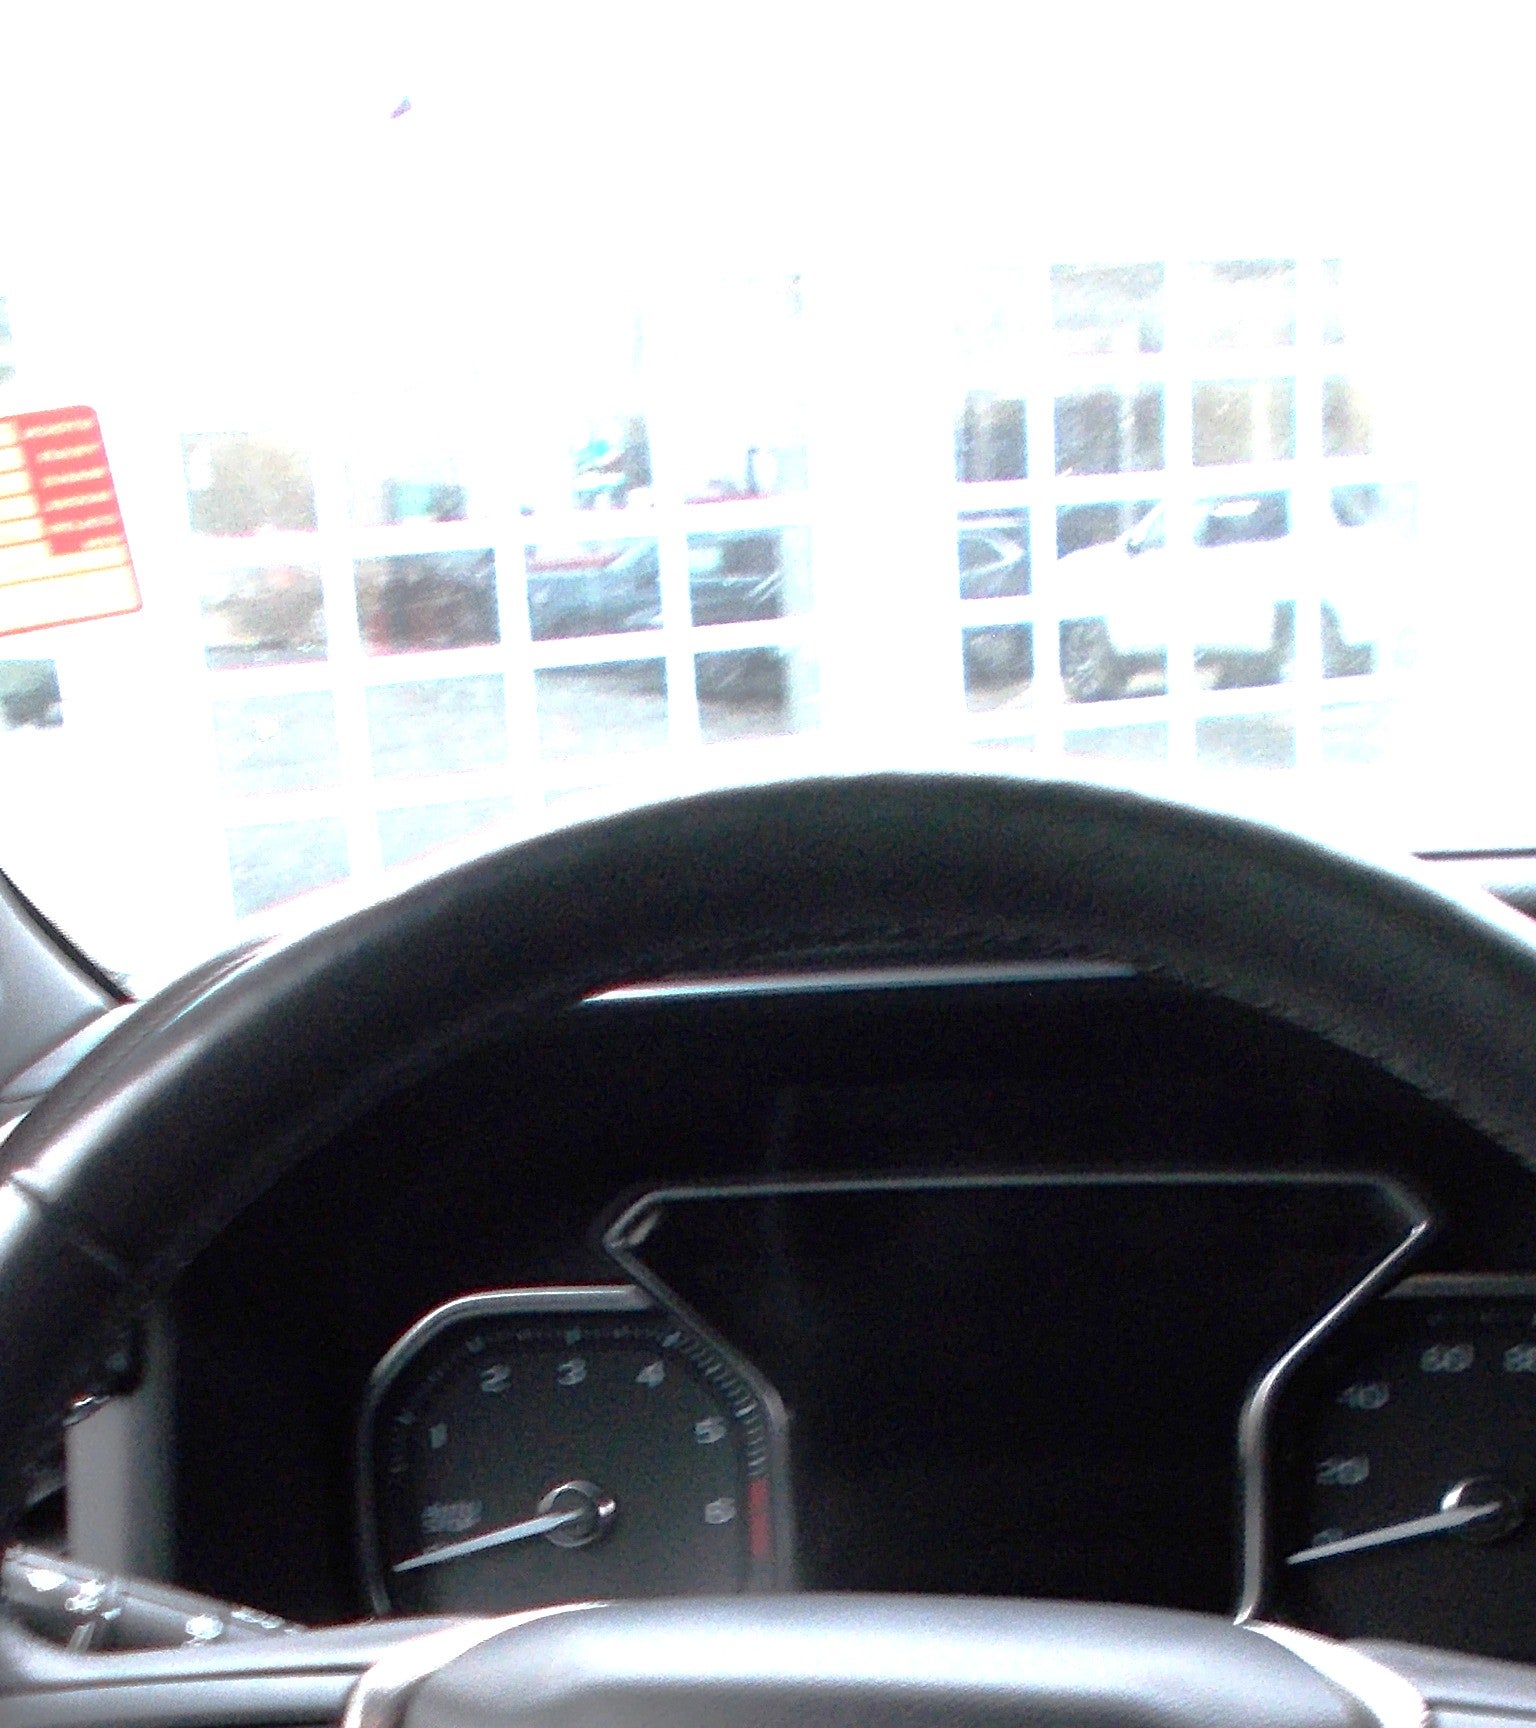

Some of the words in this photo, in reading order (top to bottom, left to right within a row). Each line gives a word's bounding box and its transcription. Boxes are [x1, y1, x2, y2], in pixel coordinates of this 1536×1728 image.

[480, 1362, 512, 1393] 2
[557, 1357, 587, 1386] 3
[635, 1359, 666, 1389] 4
[694, 1416, 728, 1444] 5
